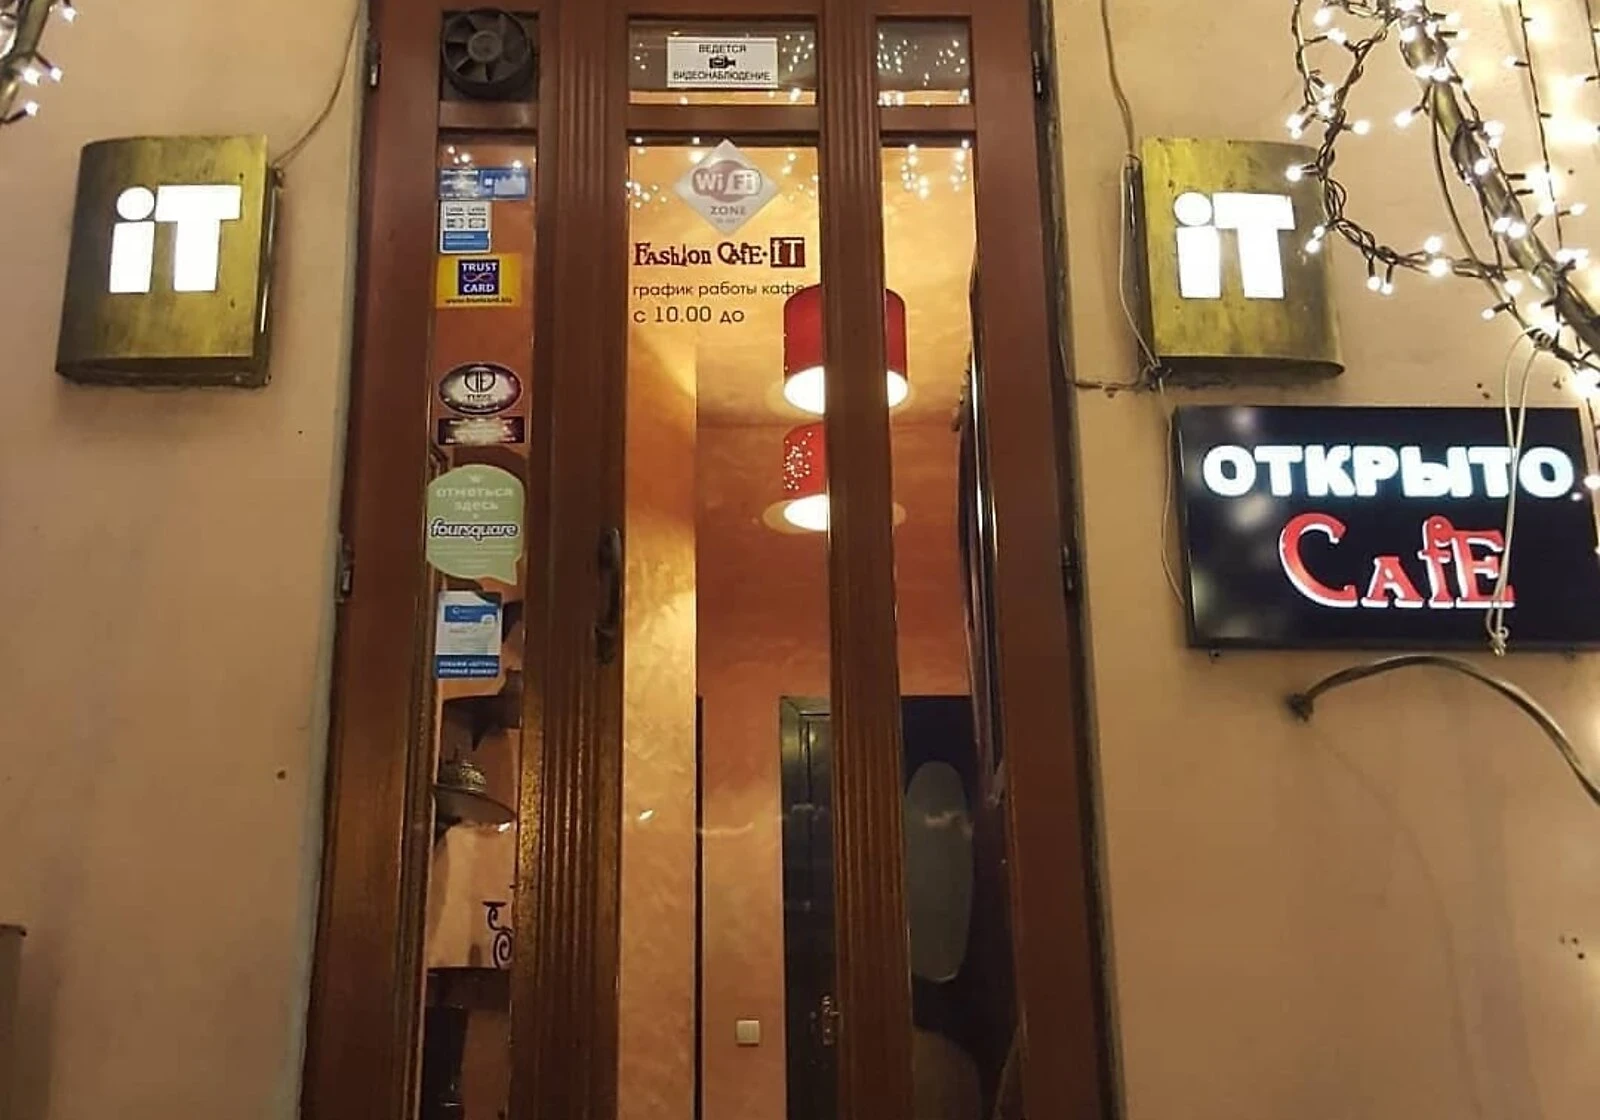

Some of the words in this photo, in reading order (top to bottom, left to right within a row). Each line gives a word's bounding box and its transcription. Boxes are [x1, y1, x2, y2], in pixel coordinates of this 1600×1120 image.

[698, 44, 747, 53] ВЕДЕТСЯ
[673, 70, 771, 81] ВИДЕОНАБЛЮДЕНИЕ
[710, 205, 747, 215] ZONE
[462, 263, 497, 272] TRUST
[464, 283, 495, 293] CARD
[633, 284, 693, 299] график
[699, 282, 757, 298] работы
[655, 306, 711, 323] 10.00
[720, 310, 744, 323] до
[1202, 444, 1575, 498] ОТКРЫТО
[432, 519, 517, 540] foursquare
